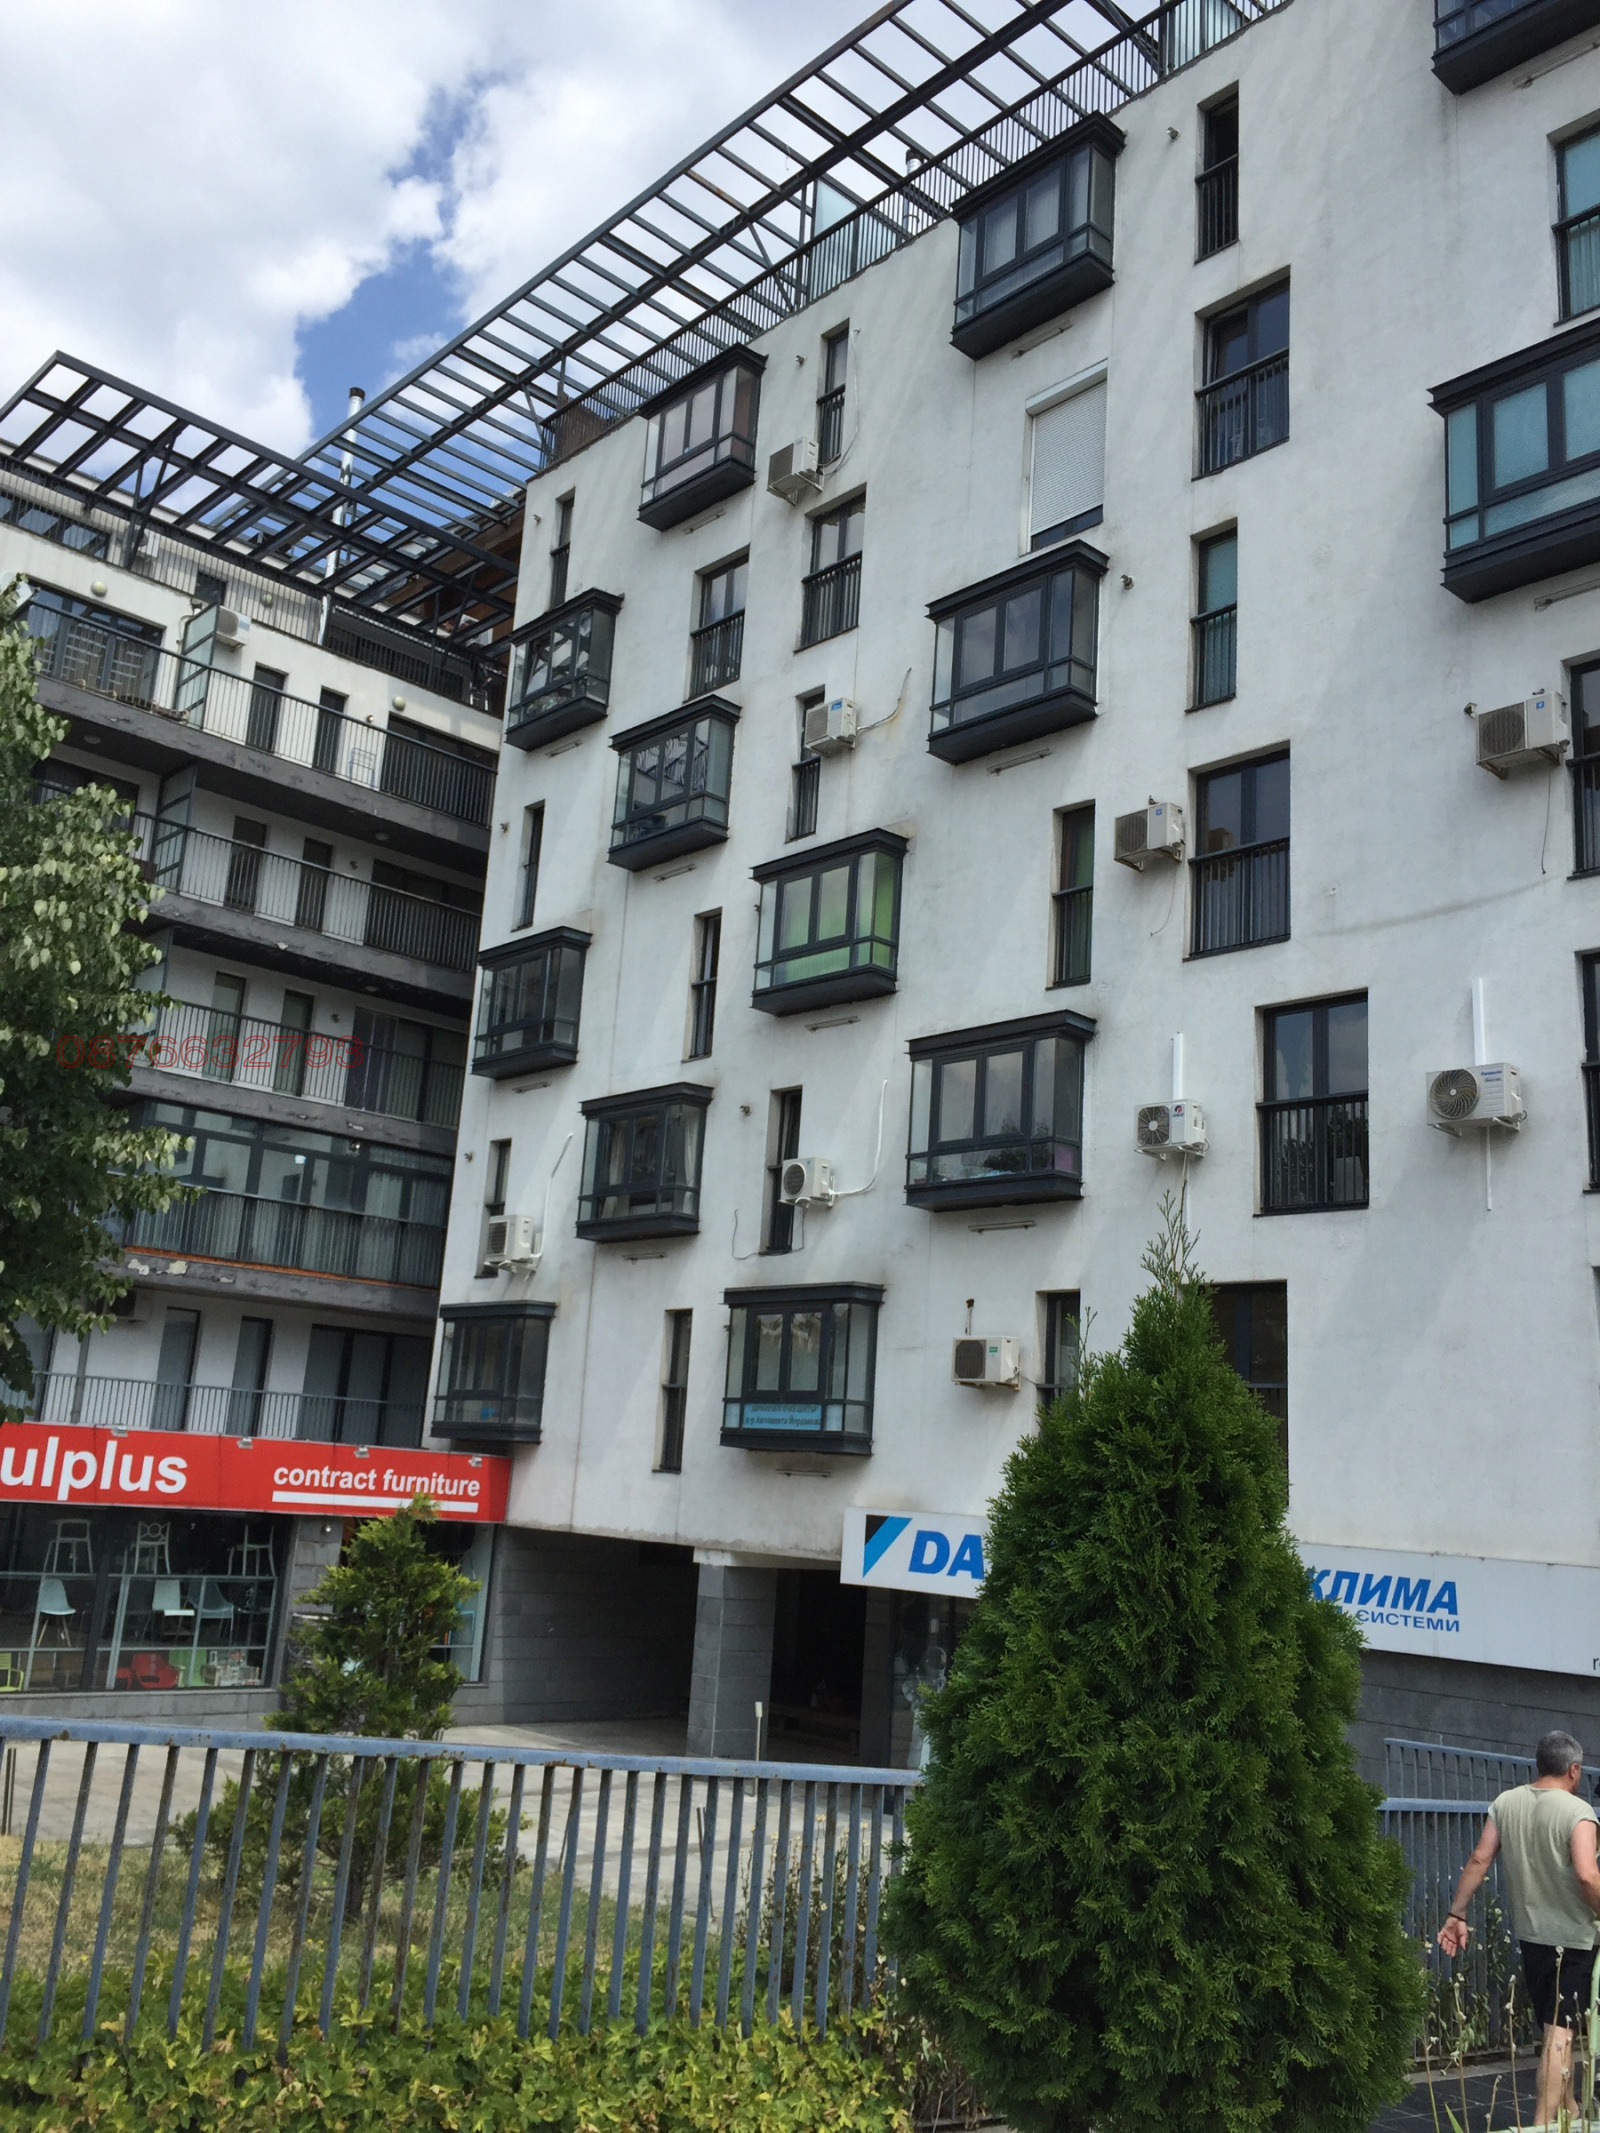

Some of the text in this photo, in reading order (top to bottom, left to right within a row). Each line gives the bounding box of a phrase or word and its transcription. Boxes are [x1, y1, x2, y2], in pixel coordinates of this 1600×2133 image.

[0, 1436, 188, 1501] ulplus
[273, 1466, 480, 1497] contract furniture
[1355, 1609, 1460, 1632] СИСТЕМИ
